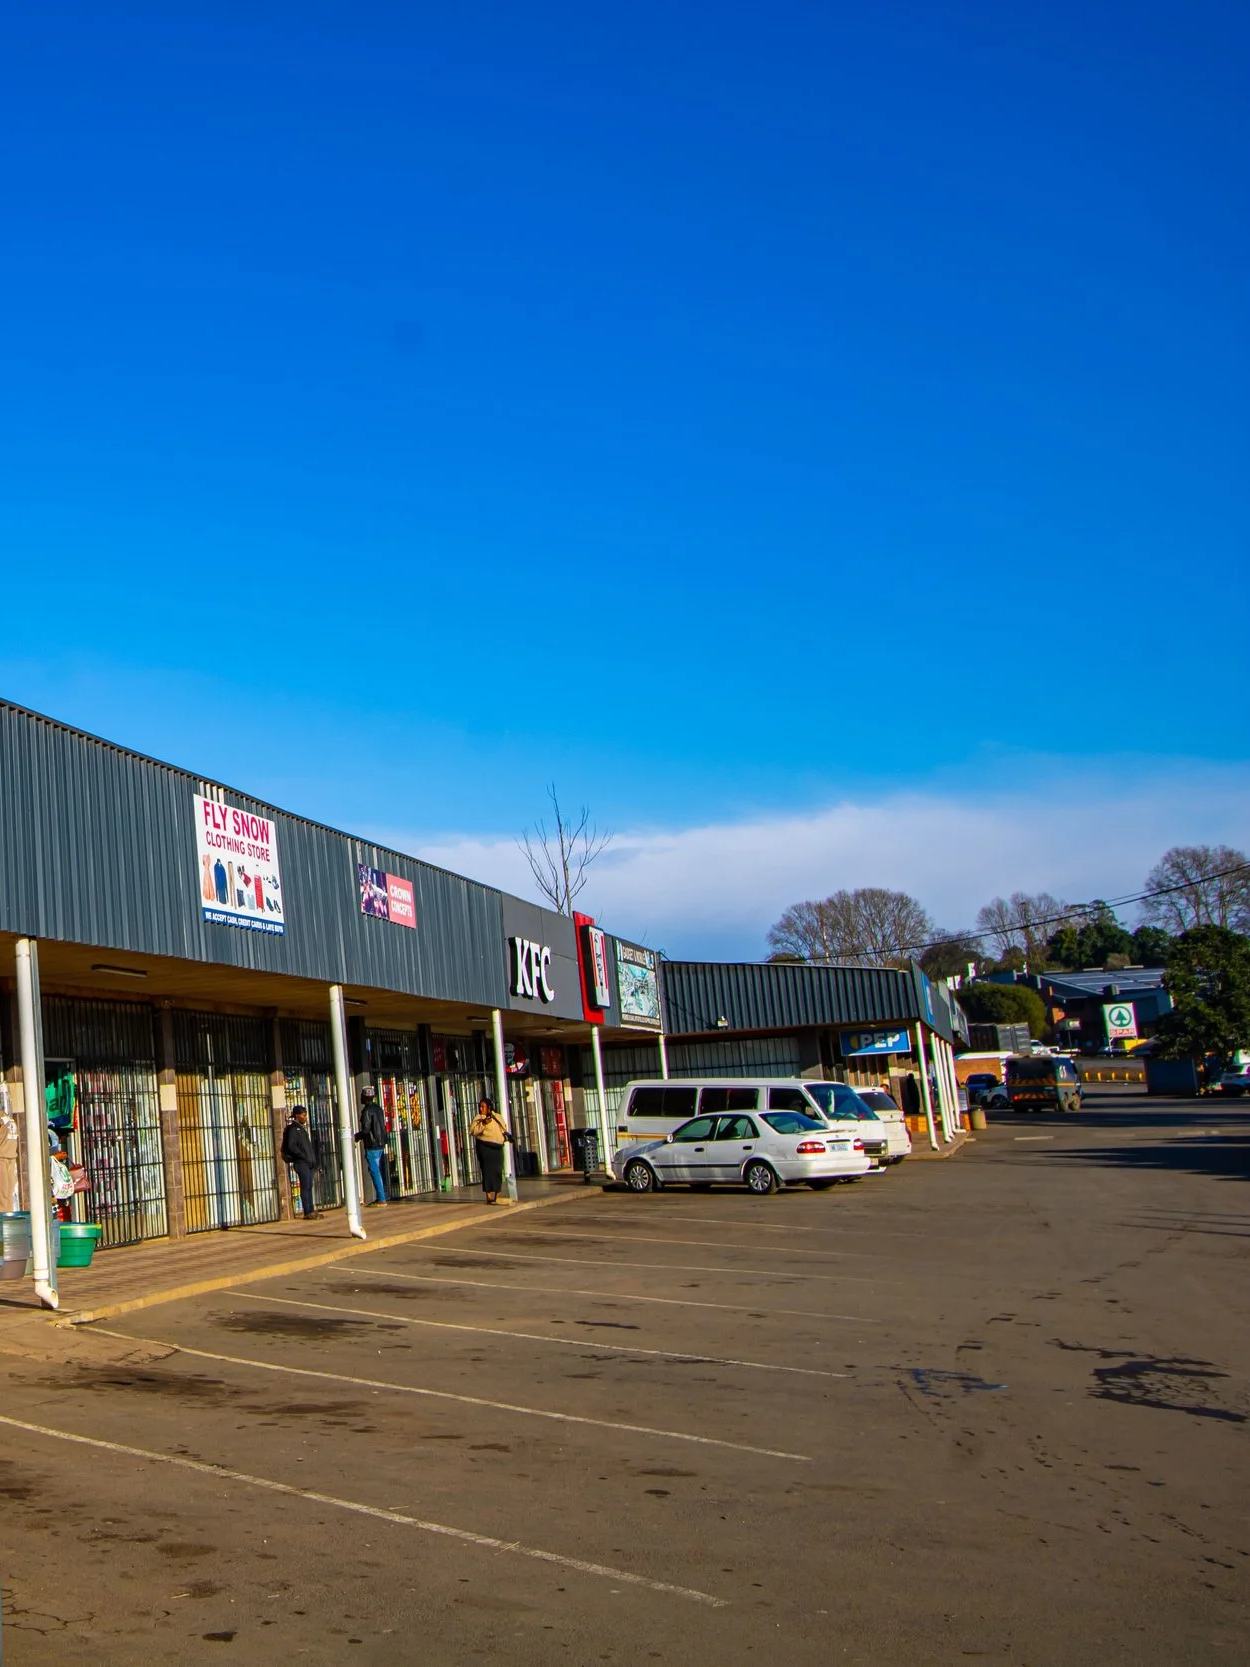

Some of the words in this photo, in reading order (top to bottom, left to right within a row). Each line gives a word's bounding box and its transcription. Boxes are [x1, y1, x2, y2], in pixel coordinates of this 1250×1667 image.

[203, 801, 228, 831] FLY
[232, 810, 270, 844] SNOW
[206, 831, 246, 855] CLOTHING
[247, 843, 270, 862] STORE
[510, 936, 555, 1003] KFC
[861, 1032, 900, 1048] PEP
